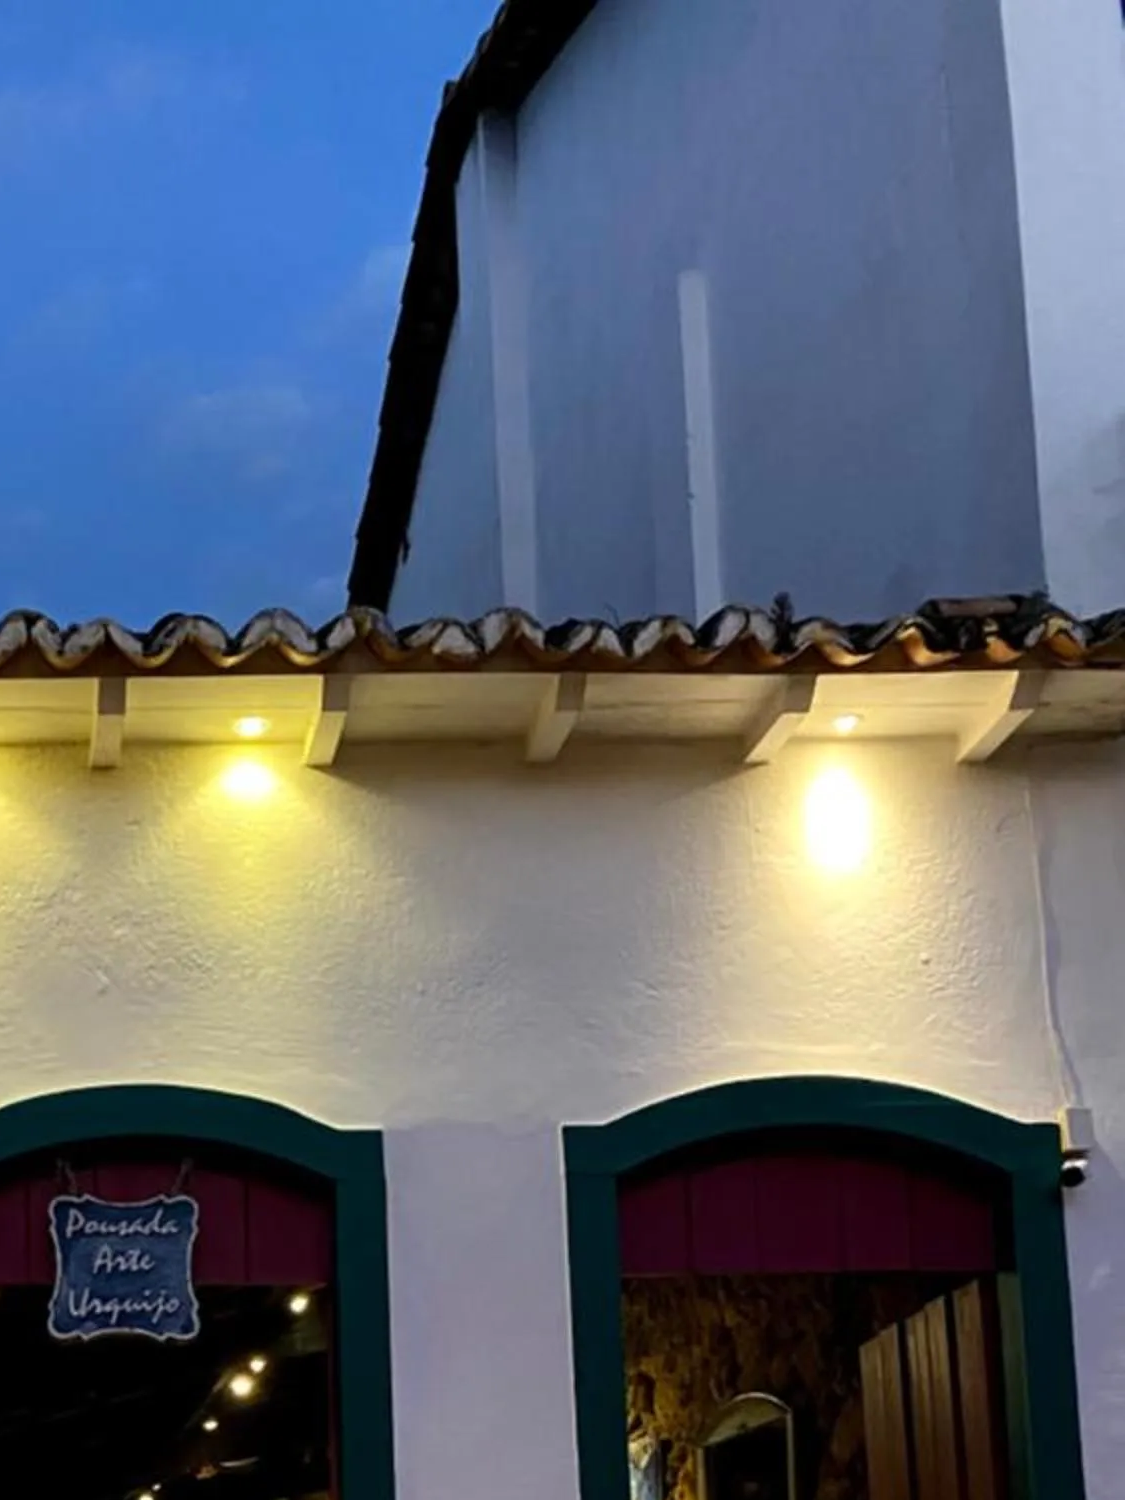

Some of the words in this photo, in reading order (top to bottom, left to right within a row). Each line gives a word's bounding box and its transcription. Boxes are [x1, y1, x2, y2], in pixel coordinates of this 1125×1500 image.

[65, 1208, 179, 1239] Pousada
[93, 1243, 155, 1273] Arte
[68, 1287, 180, 1325] Urquijo
